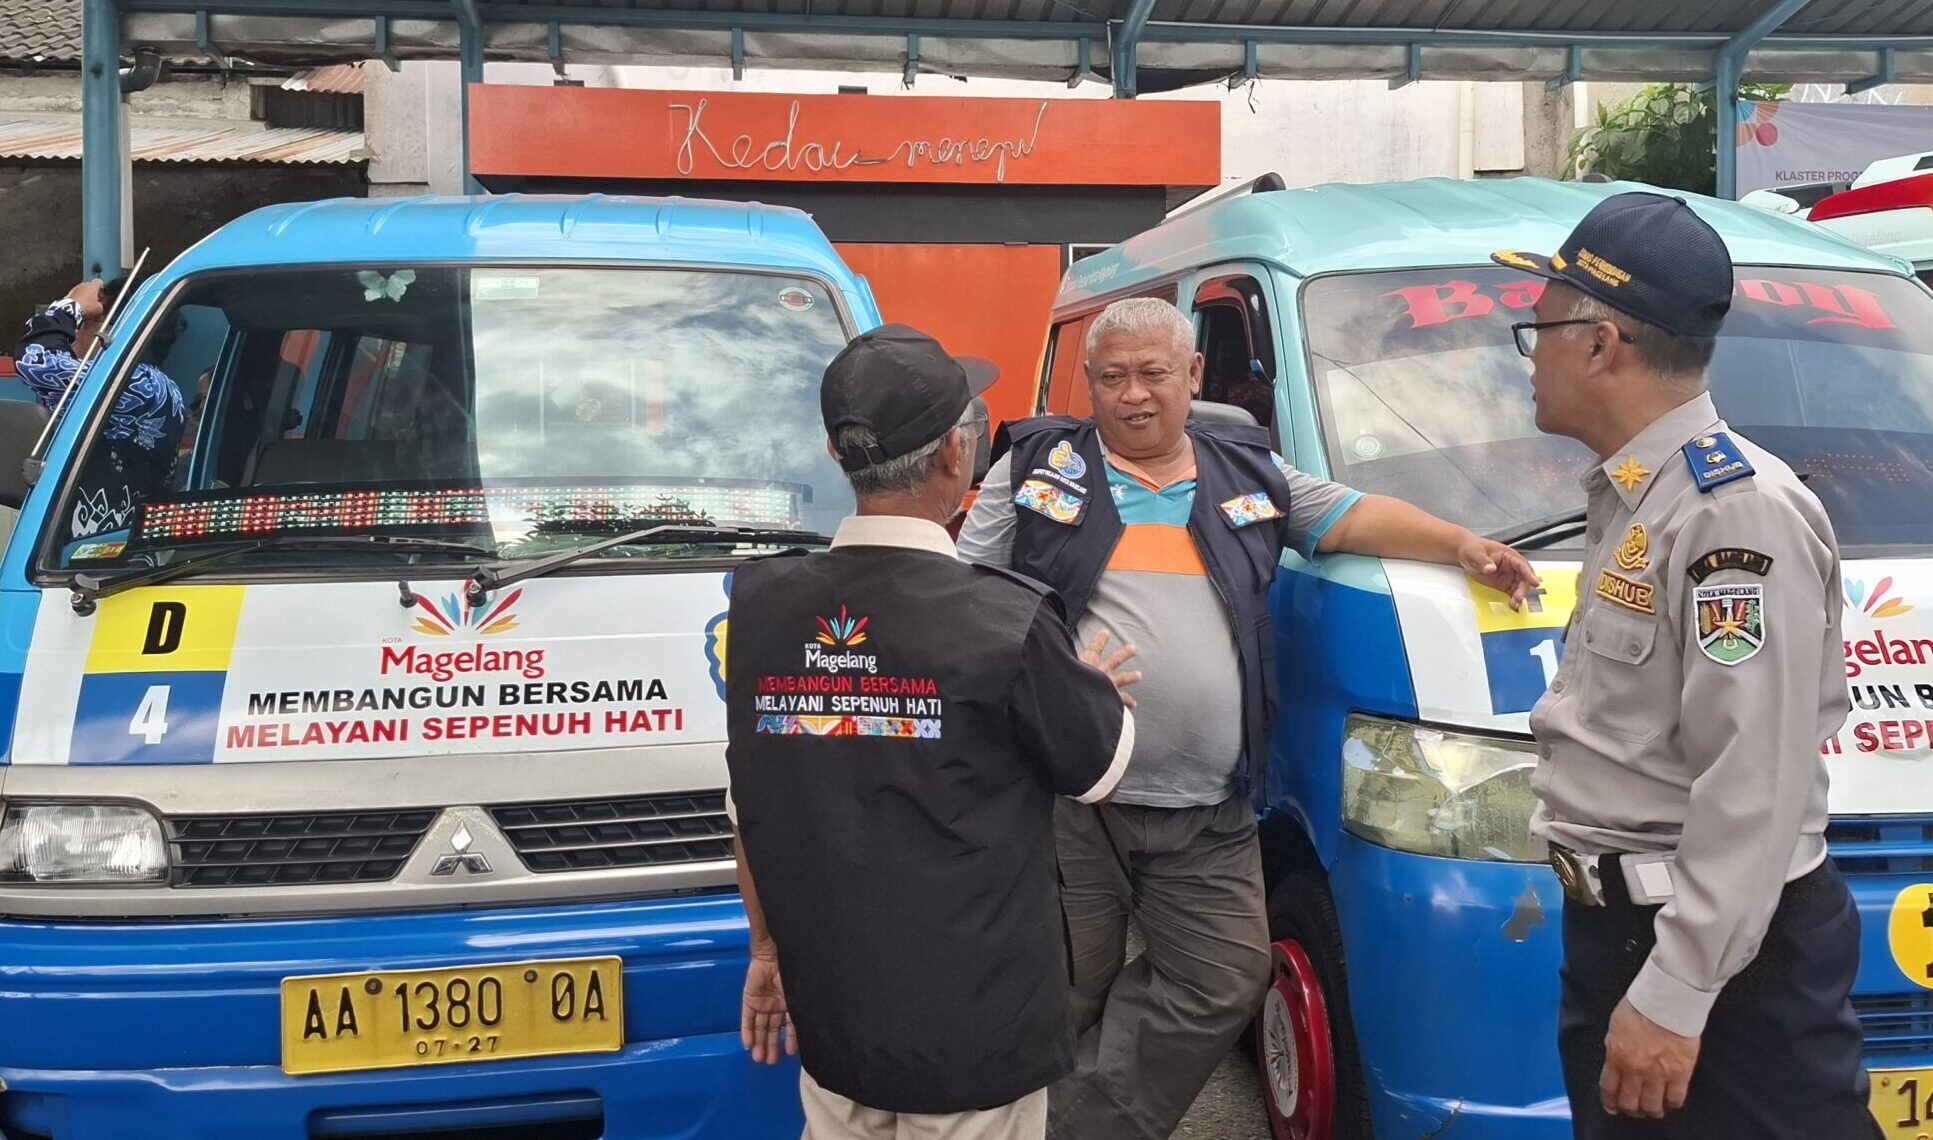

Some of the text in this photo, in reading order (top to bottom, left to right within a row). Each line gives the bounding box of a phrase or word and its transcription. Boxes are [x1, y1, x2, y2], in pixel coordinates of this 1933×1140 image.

[1775, 170, 1864, 182] KLASTER PROG
[1703, 461, 1744, 480] DISHUB
[1599, 574, 1650, 606] DISHUB
[1719, 588, 1758, 597] MAGELANG
[141, 601, 187, 655] D
[382, 636, 402, 644] KOTA
[380, 643, 546, 682] Magelang
[805, 649, 877, 673] Magelang
[248, 678, 669, 716] MEMBANGUN BERSAMA
[757, 674, 937, 695] MEMBANGUN BERSAMA
[1848, 684, 1911, 713] UN
[128, 685, 171, 745] 4
[755, 695, 942, 716] MELAYANI SEPENUH HATI
[226, 708, 683, 749] MELAYANI SEPENUH HATI
[303, 987, 359, 1040] AA
[394, 976, 504, 1033] 1380
